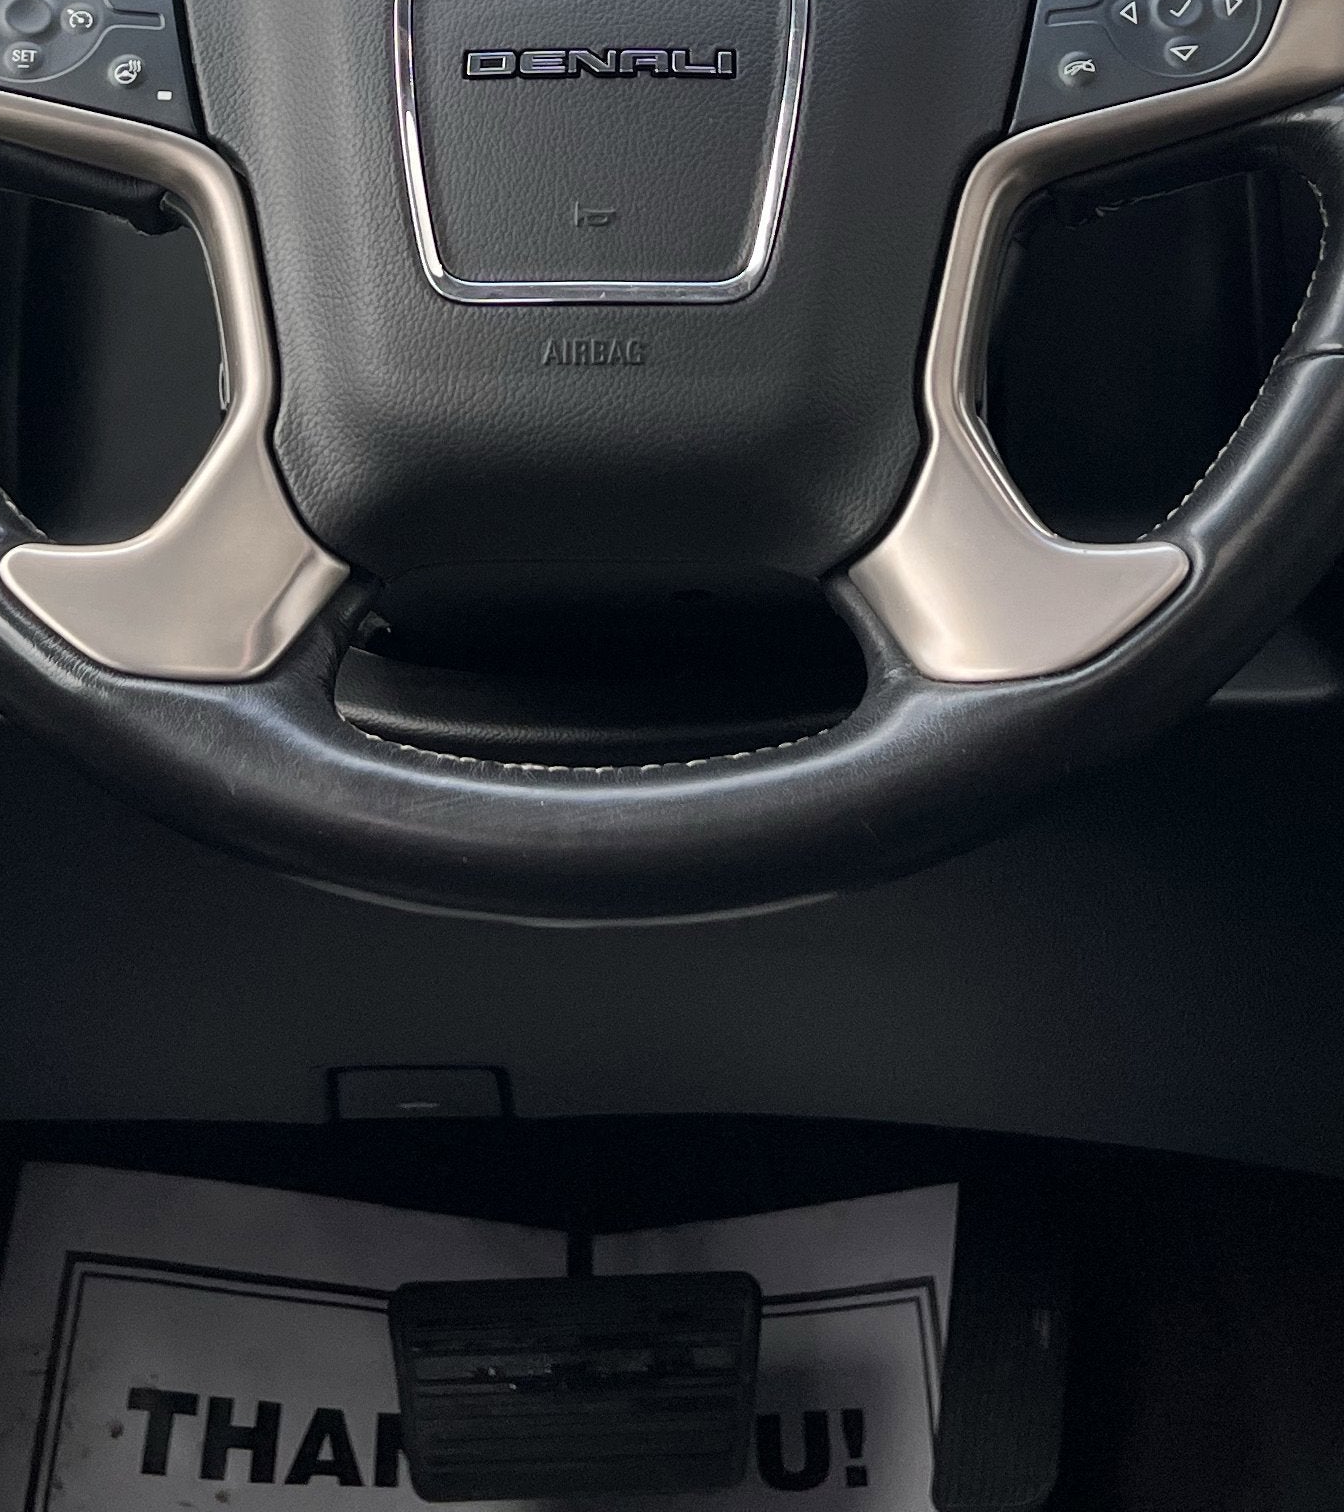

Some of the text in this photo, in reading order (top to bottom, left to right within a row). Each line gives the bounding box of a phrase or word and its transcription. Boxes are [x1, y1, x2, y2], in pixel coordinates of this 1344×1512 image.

[12, 49, 38, 63] SET
[463, 49, 736, 78] DENALI
[542, 339, 646, 366] AIRBAG
